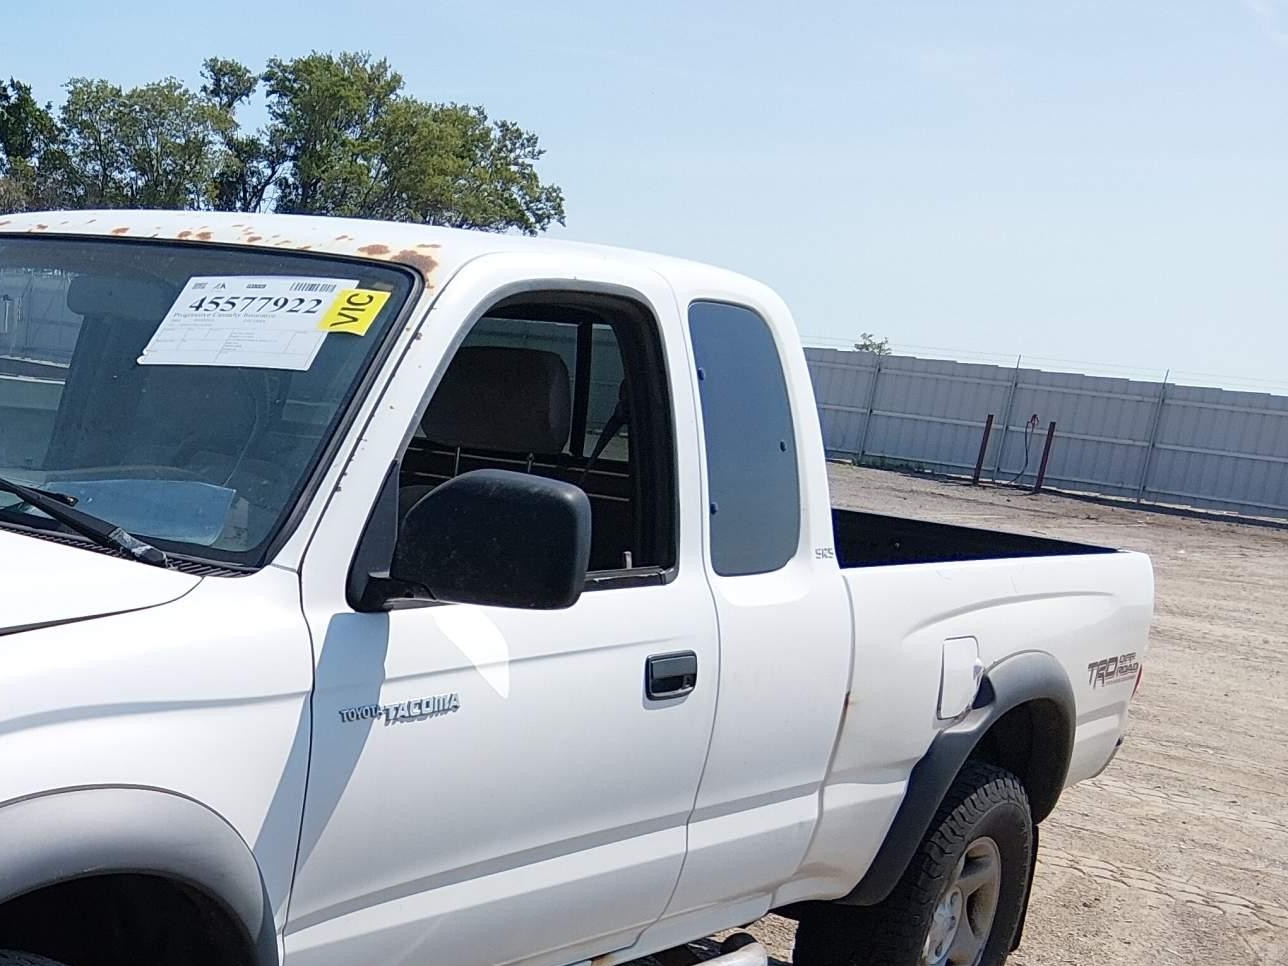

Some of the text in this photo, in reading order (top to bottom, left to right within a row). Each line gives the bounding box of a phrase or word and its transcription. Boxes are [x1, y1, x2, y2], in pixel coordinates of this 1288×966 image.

[188, 295, 323, 314] 45577922
[329, 293, 374, 328] VIC
[1087, 655, 1119, 690] TRD
[338, 691, 461, 723] TOYOTA TACOMA
